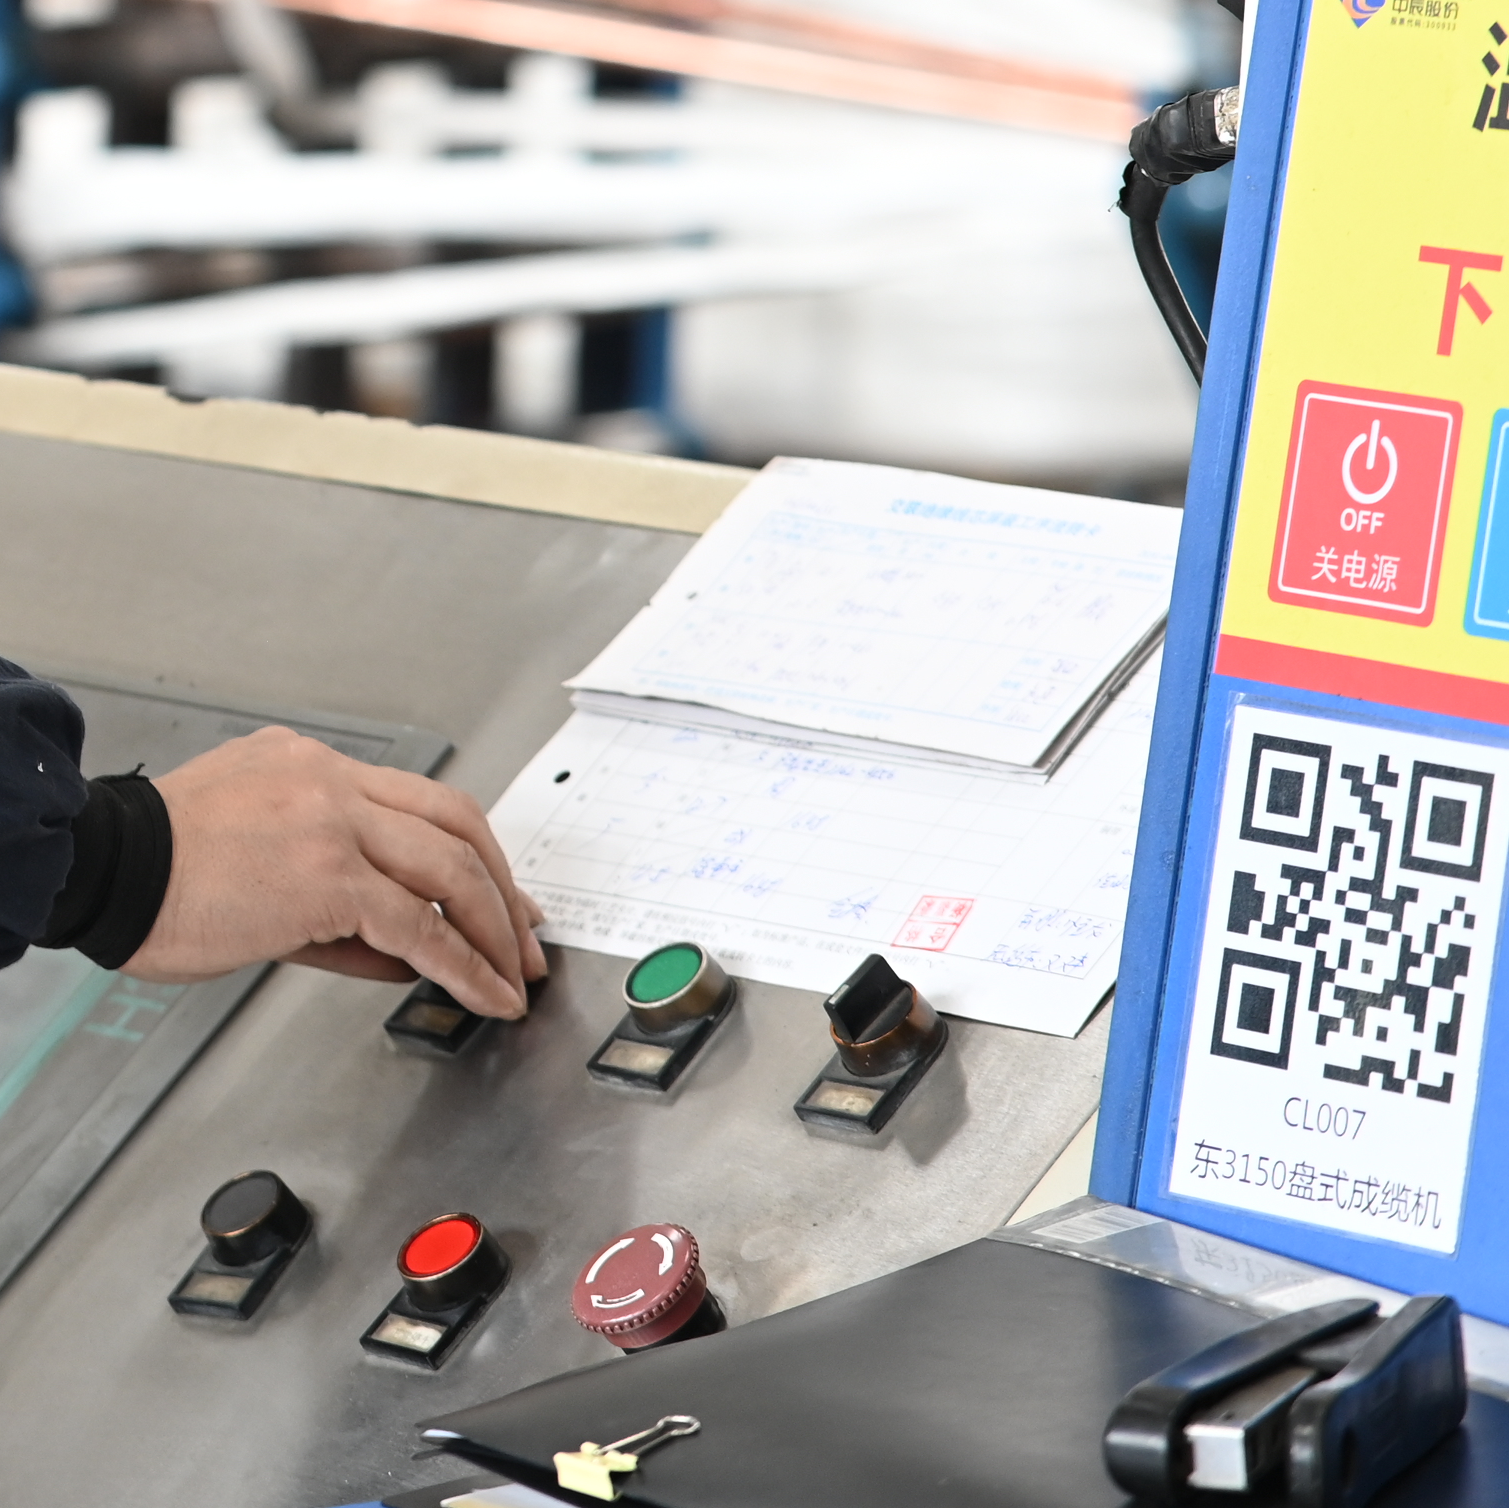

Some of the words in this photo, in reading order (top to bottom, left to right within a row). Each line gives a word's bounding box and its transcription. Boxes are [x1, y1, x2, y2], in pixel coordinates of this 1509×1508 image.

[1418, 244, 1504, 357] 下
[1339, 507, 1385, 535] OFF
[1310, 545, 1401, 593] 关电源
[1283, 1096, 1367, 1140] CL007
[1190, 1138, 1442, 1230] 东3150盘式成缆机
